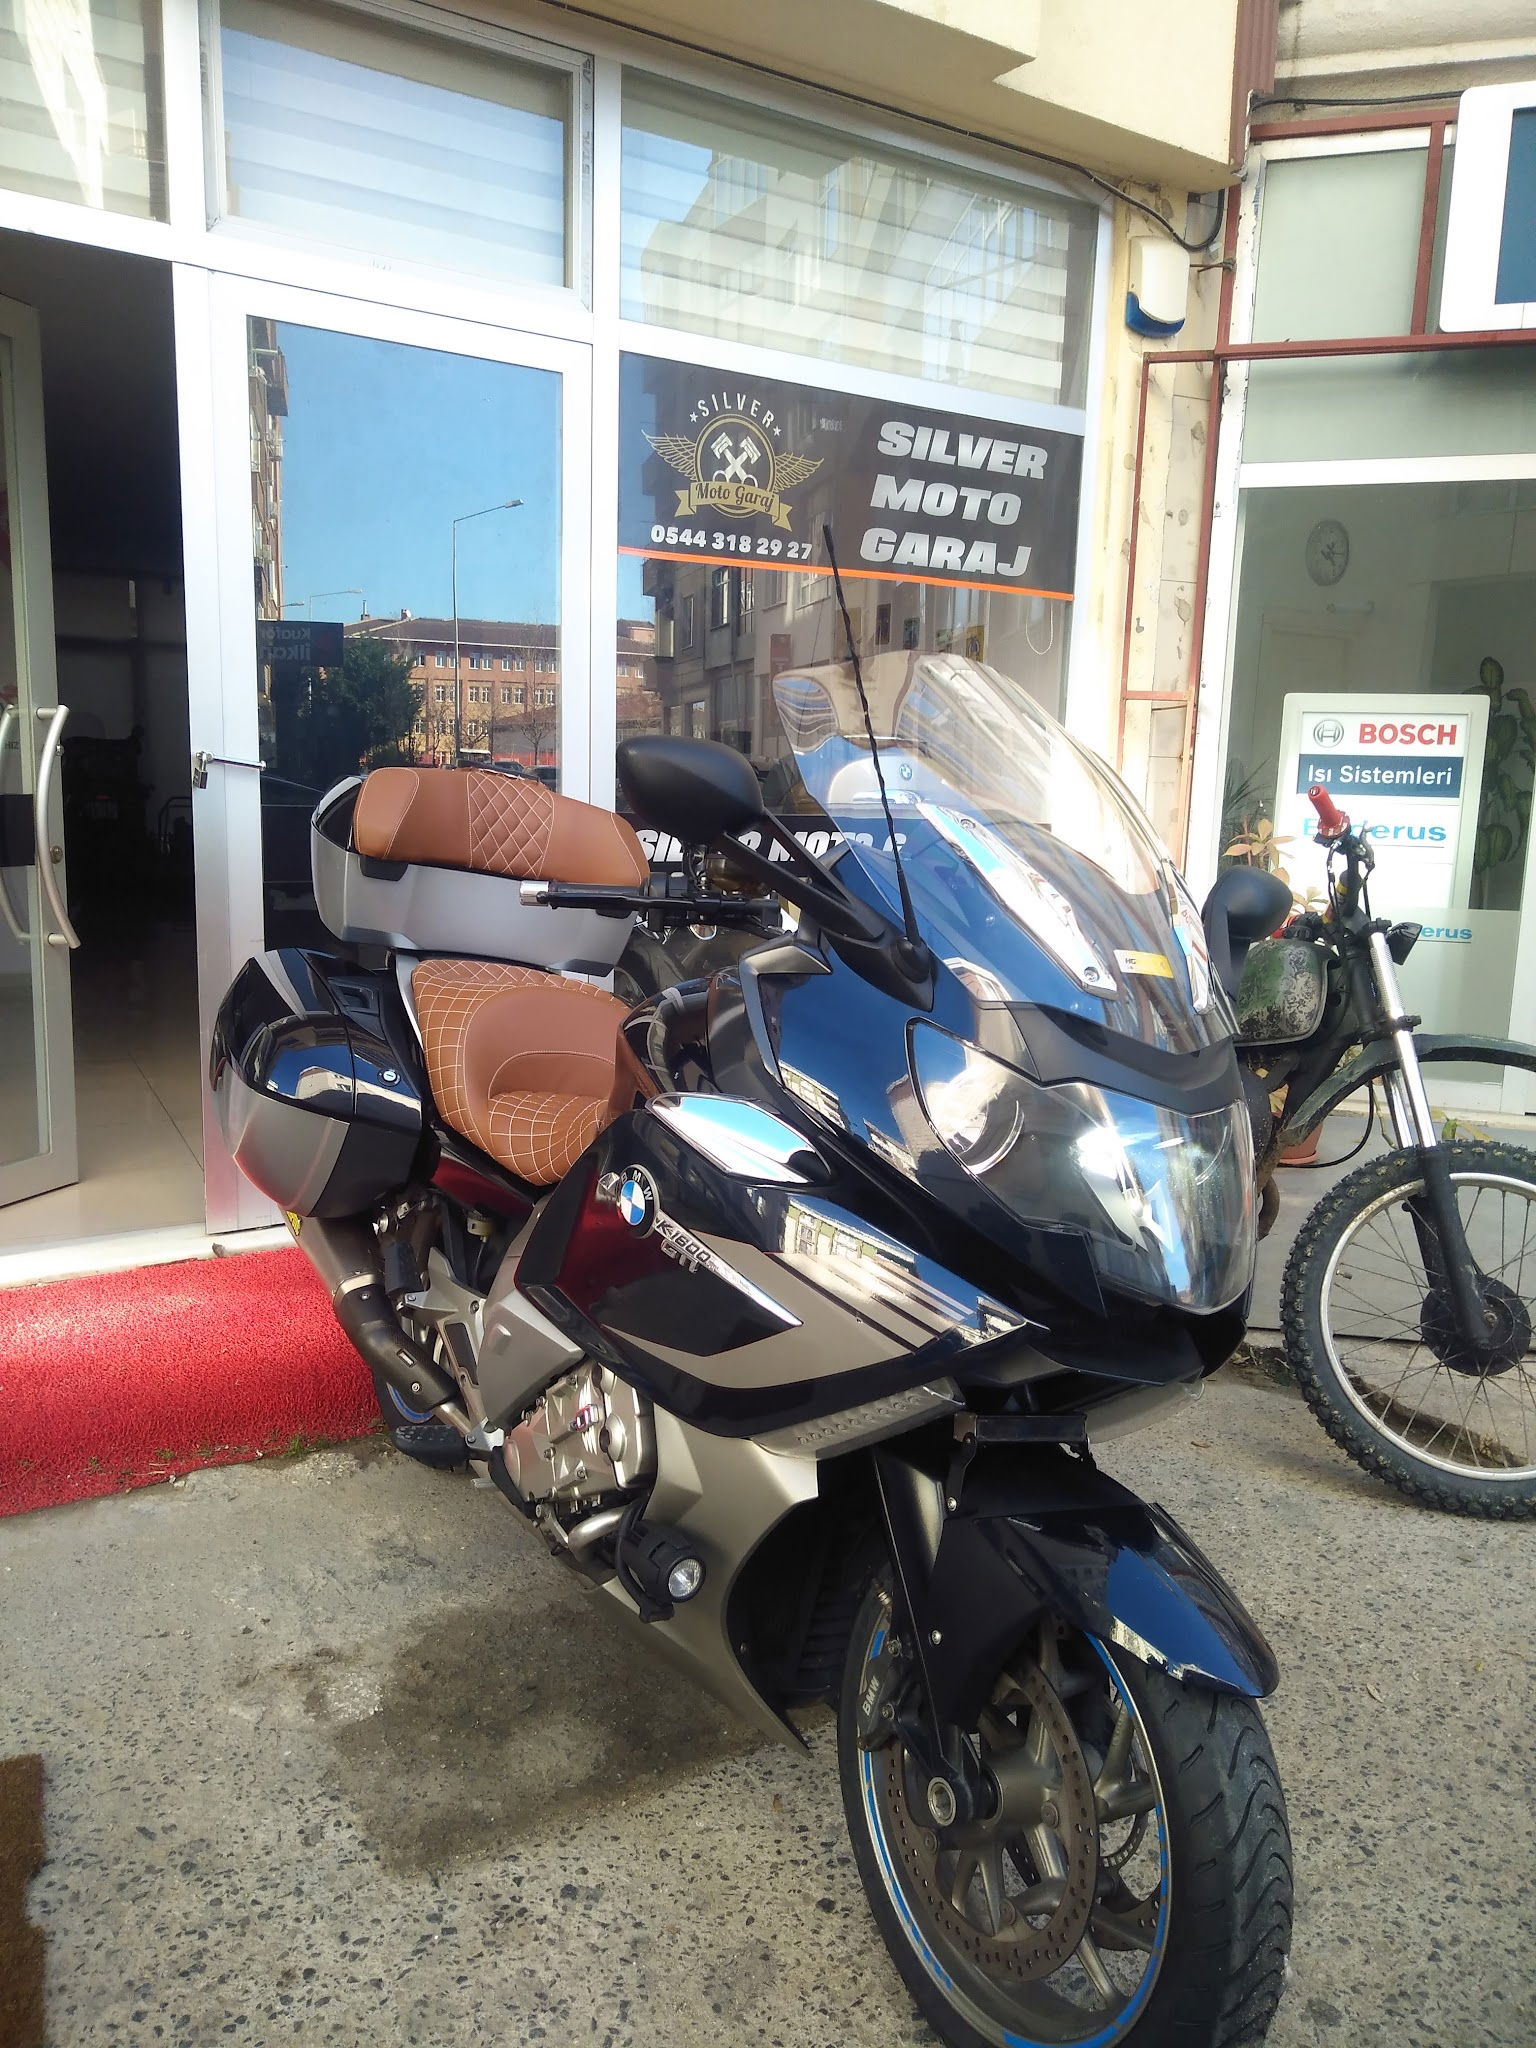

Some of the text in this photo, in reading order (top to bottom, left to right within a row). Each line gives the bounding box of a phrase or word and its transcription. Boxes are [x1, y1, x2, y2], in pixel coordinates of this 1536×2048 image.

[697, 392, 775, 428] SILVER
[877, 420, 1049, 480] SILVER
[695, 482, 775, 512] Moto Garaj
[870, 474, 1021, 526] MOTO
[651, 525, 813, 560] 0544 318 29 27
[859, 527, 1032, 577] GARAJ
[1359, 723, 1458, 745] BOSCH
[1308, 764, 1452, 785] Isı Sistemleri
[620, 1169, 653, 1201] BMW
[862, 1675, 879, 1716] BMW
